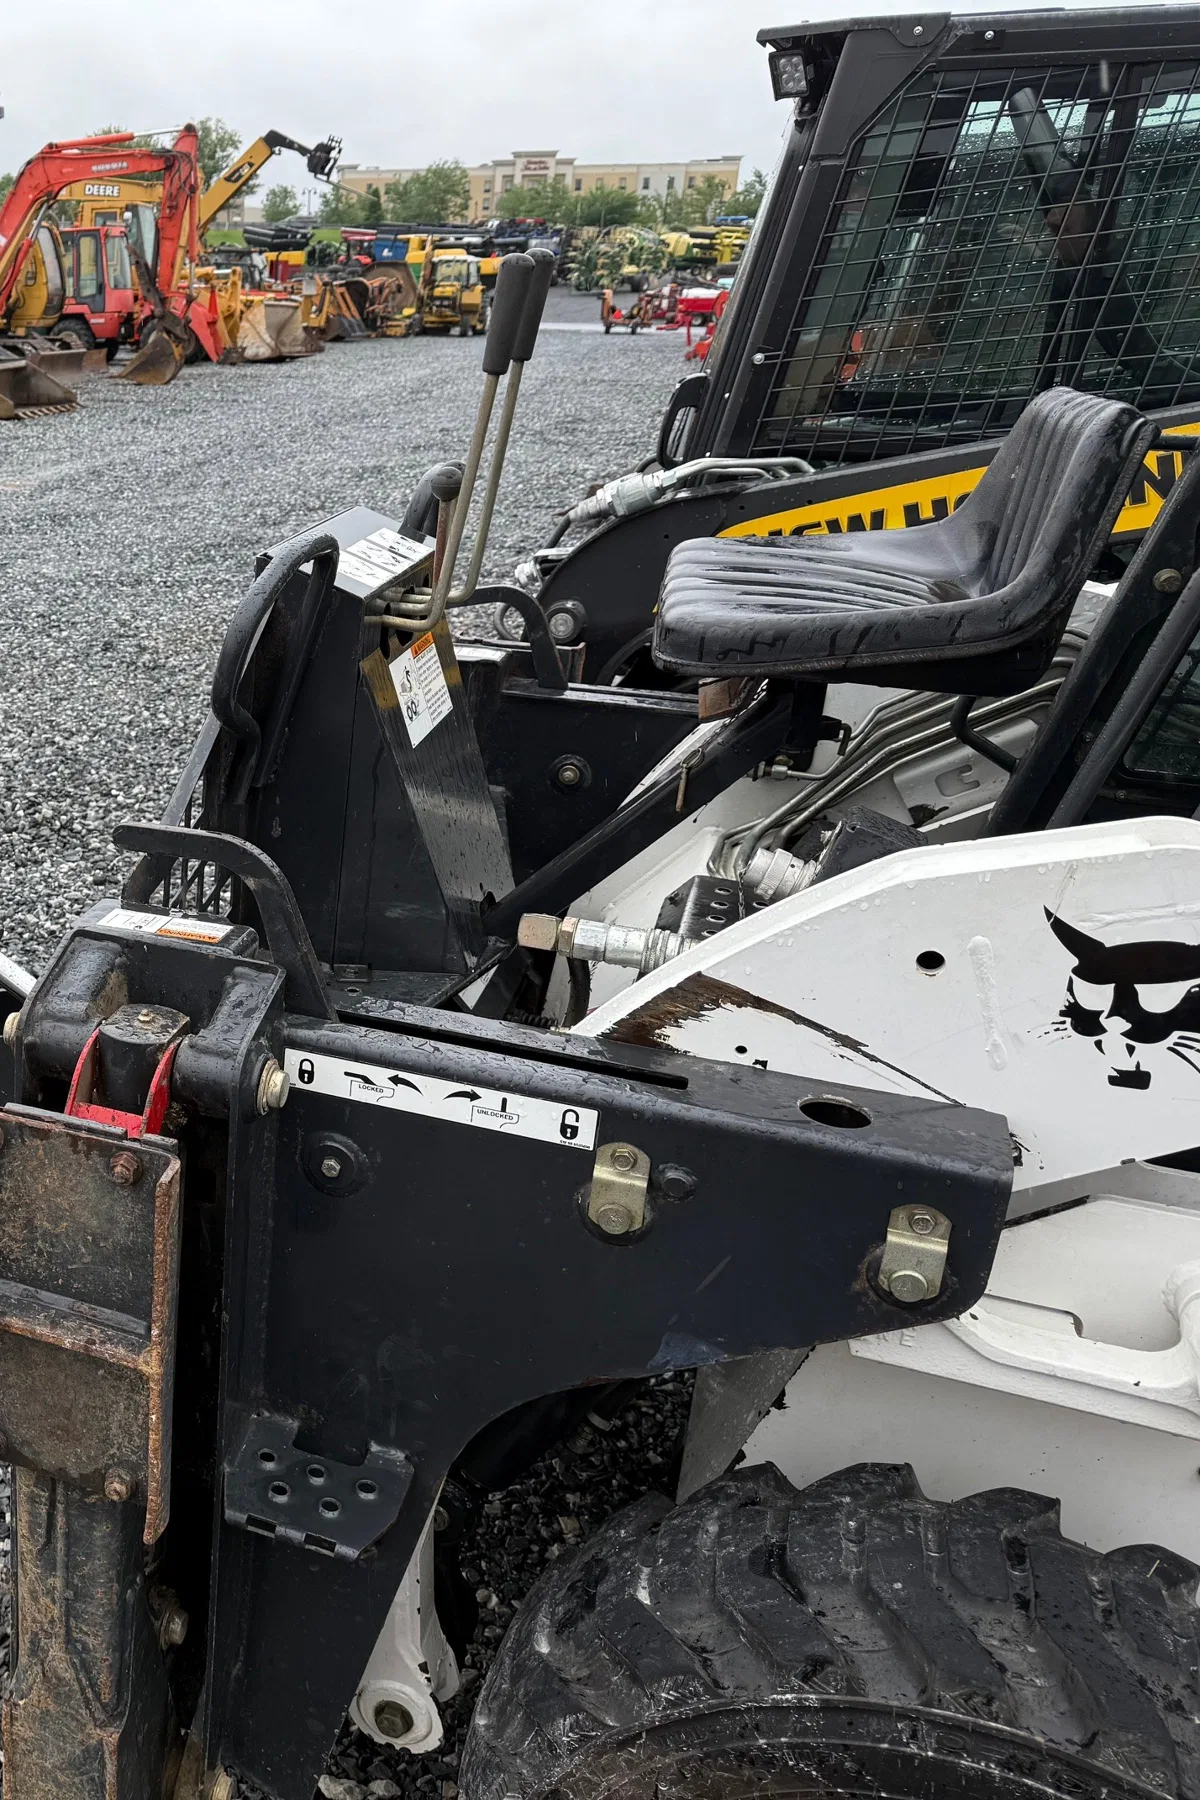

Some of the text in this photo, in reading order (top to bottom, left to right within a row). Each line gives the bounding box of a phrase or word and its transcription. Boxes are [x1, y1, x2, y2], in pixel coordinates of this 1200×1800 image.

[85, 184, 120, 197] DEERE
[358, 1083, 384, 1094] LOCKED
[476, 1108, 515, 1121] UNLOCKED
